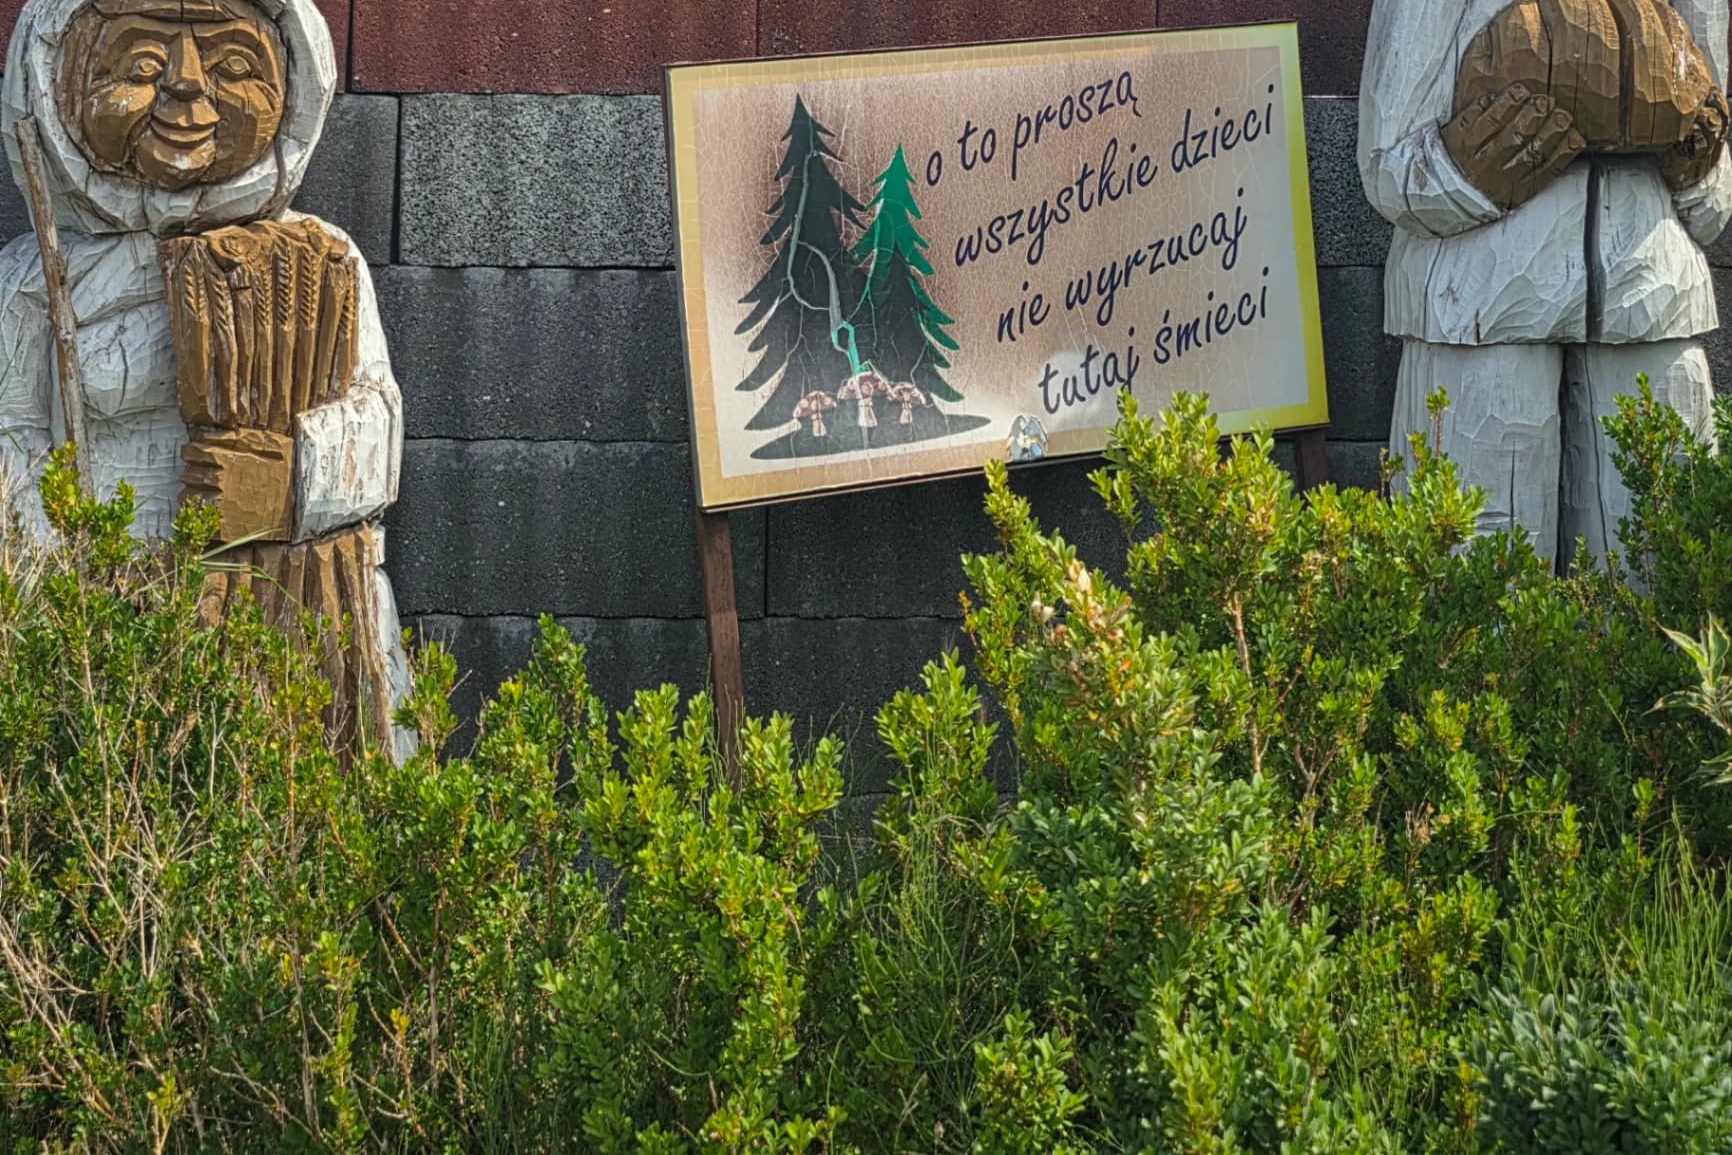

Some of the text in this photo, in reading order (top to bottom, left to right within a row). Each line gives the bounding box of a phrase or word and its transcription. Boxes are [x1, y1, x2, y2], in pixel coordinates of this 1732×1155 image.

[926, 70, 1143, 187] o to proszą
[953, 83, 1275, 267] wszystkie dzieci
[995, 187, 1248, 344] nie wyrzucaj
[1037, 266, 1269, 415] tutaj śmieci
